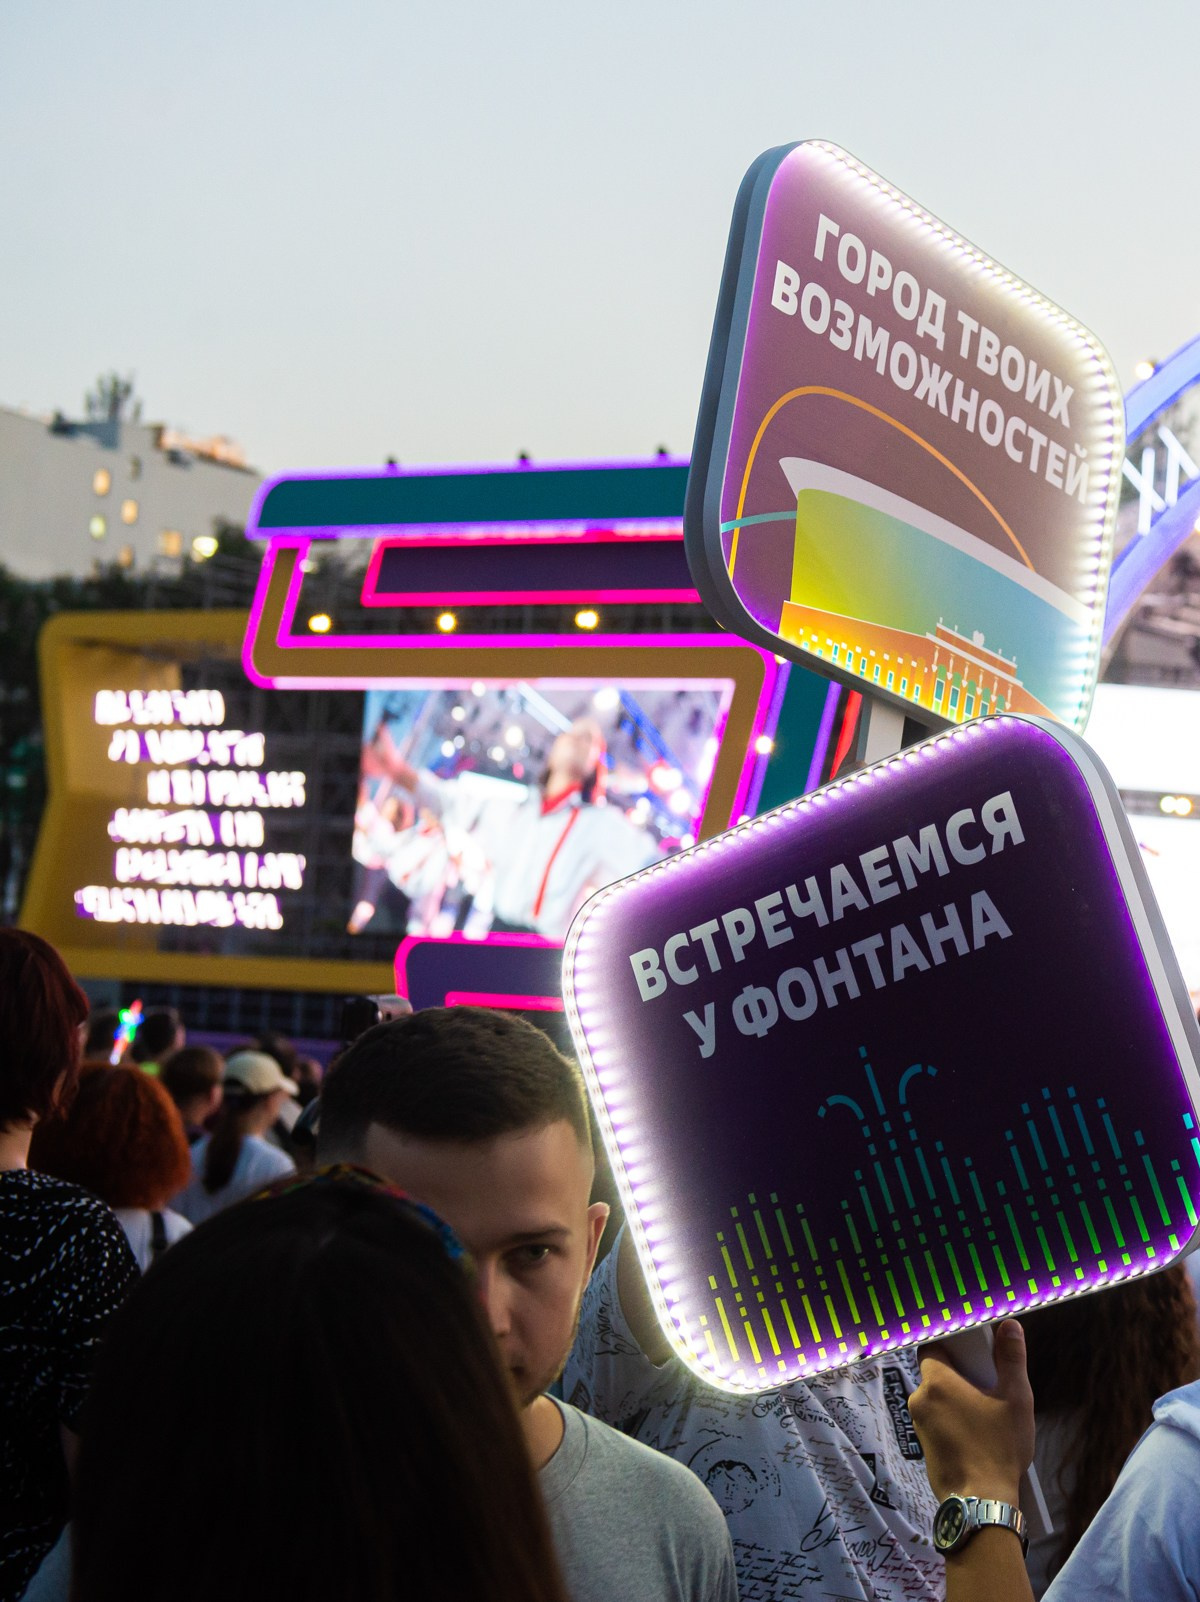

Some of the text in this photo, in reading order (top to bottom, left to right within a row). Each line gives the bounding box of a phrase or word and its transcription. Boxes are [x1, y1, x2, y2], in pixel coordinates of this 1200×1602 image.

[771, 260, 1092, 505] ВОЗМОЖНОСТЕЙ
[814, 213, 1075, 428] ГОРОД ТВОИХ
[628, 790, 1026, 1002] ВСТРЕЧАЕМСЯ
[731, 890, 1013, 1039] ФОНТАНА
[882, 1370, 920, 1455] FRAGILE
